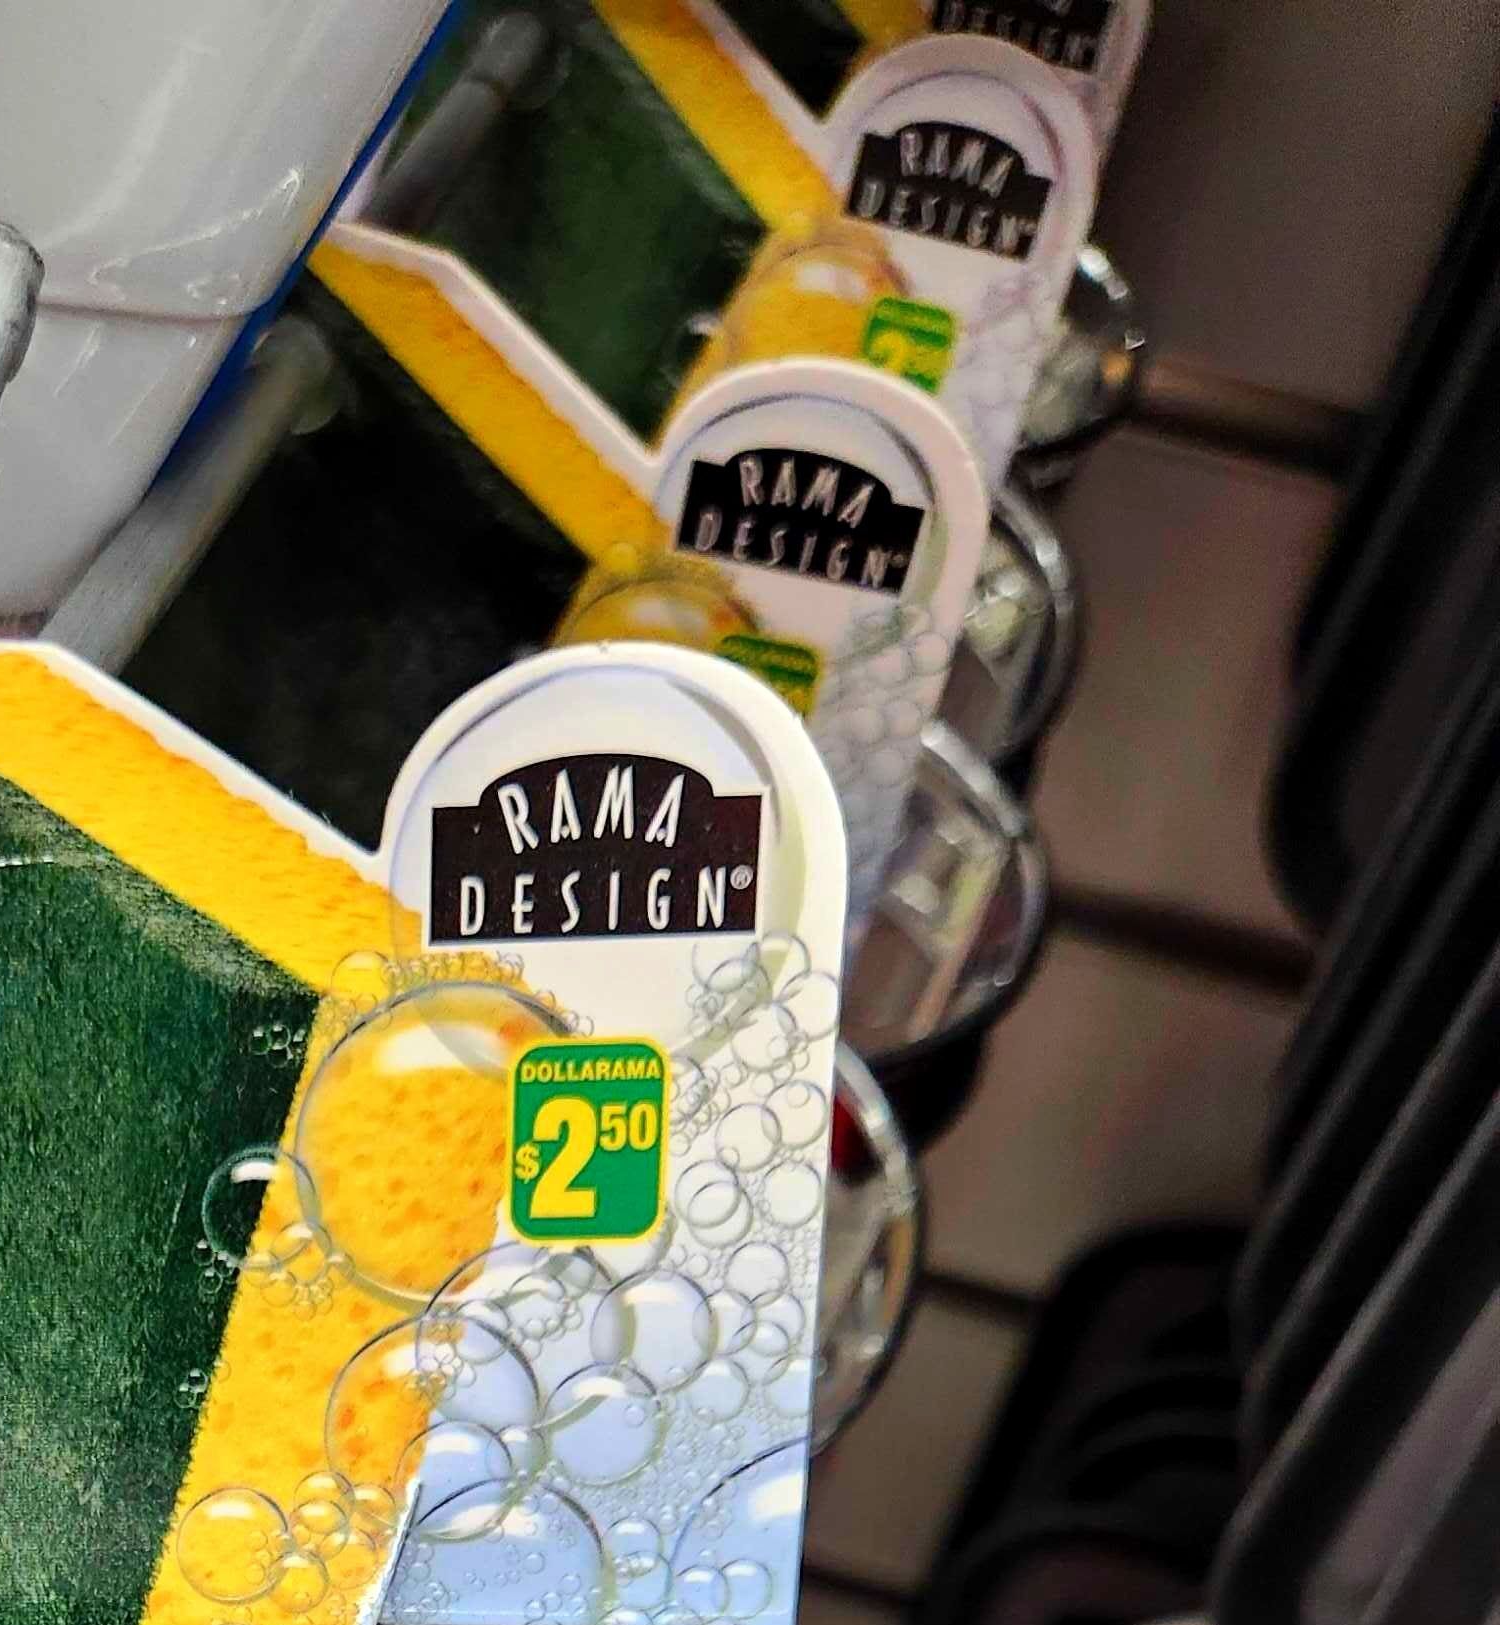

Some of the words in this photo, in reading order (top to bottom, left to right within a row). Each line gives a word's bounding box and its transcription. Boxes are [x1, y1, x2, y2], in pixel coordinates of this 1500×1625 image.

[739, 455, 876, 530] RAMA
[497, 764, 687, 855] RAMA
[519, 1055, 663, 1084] DOLLARAMA
